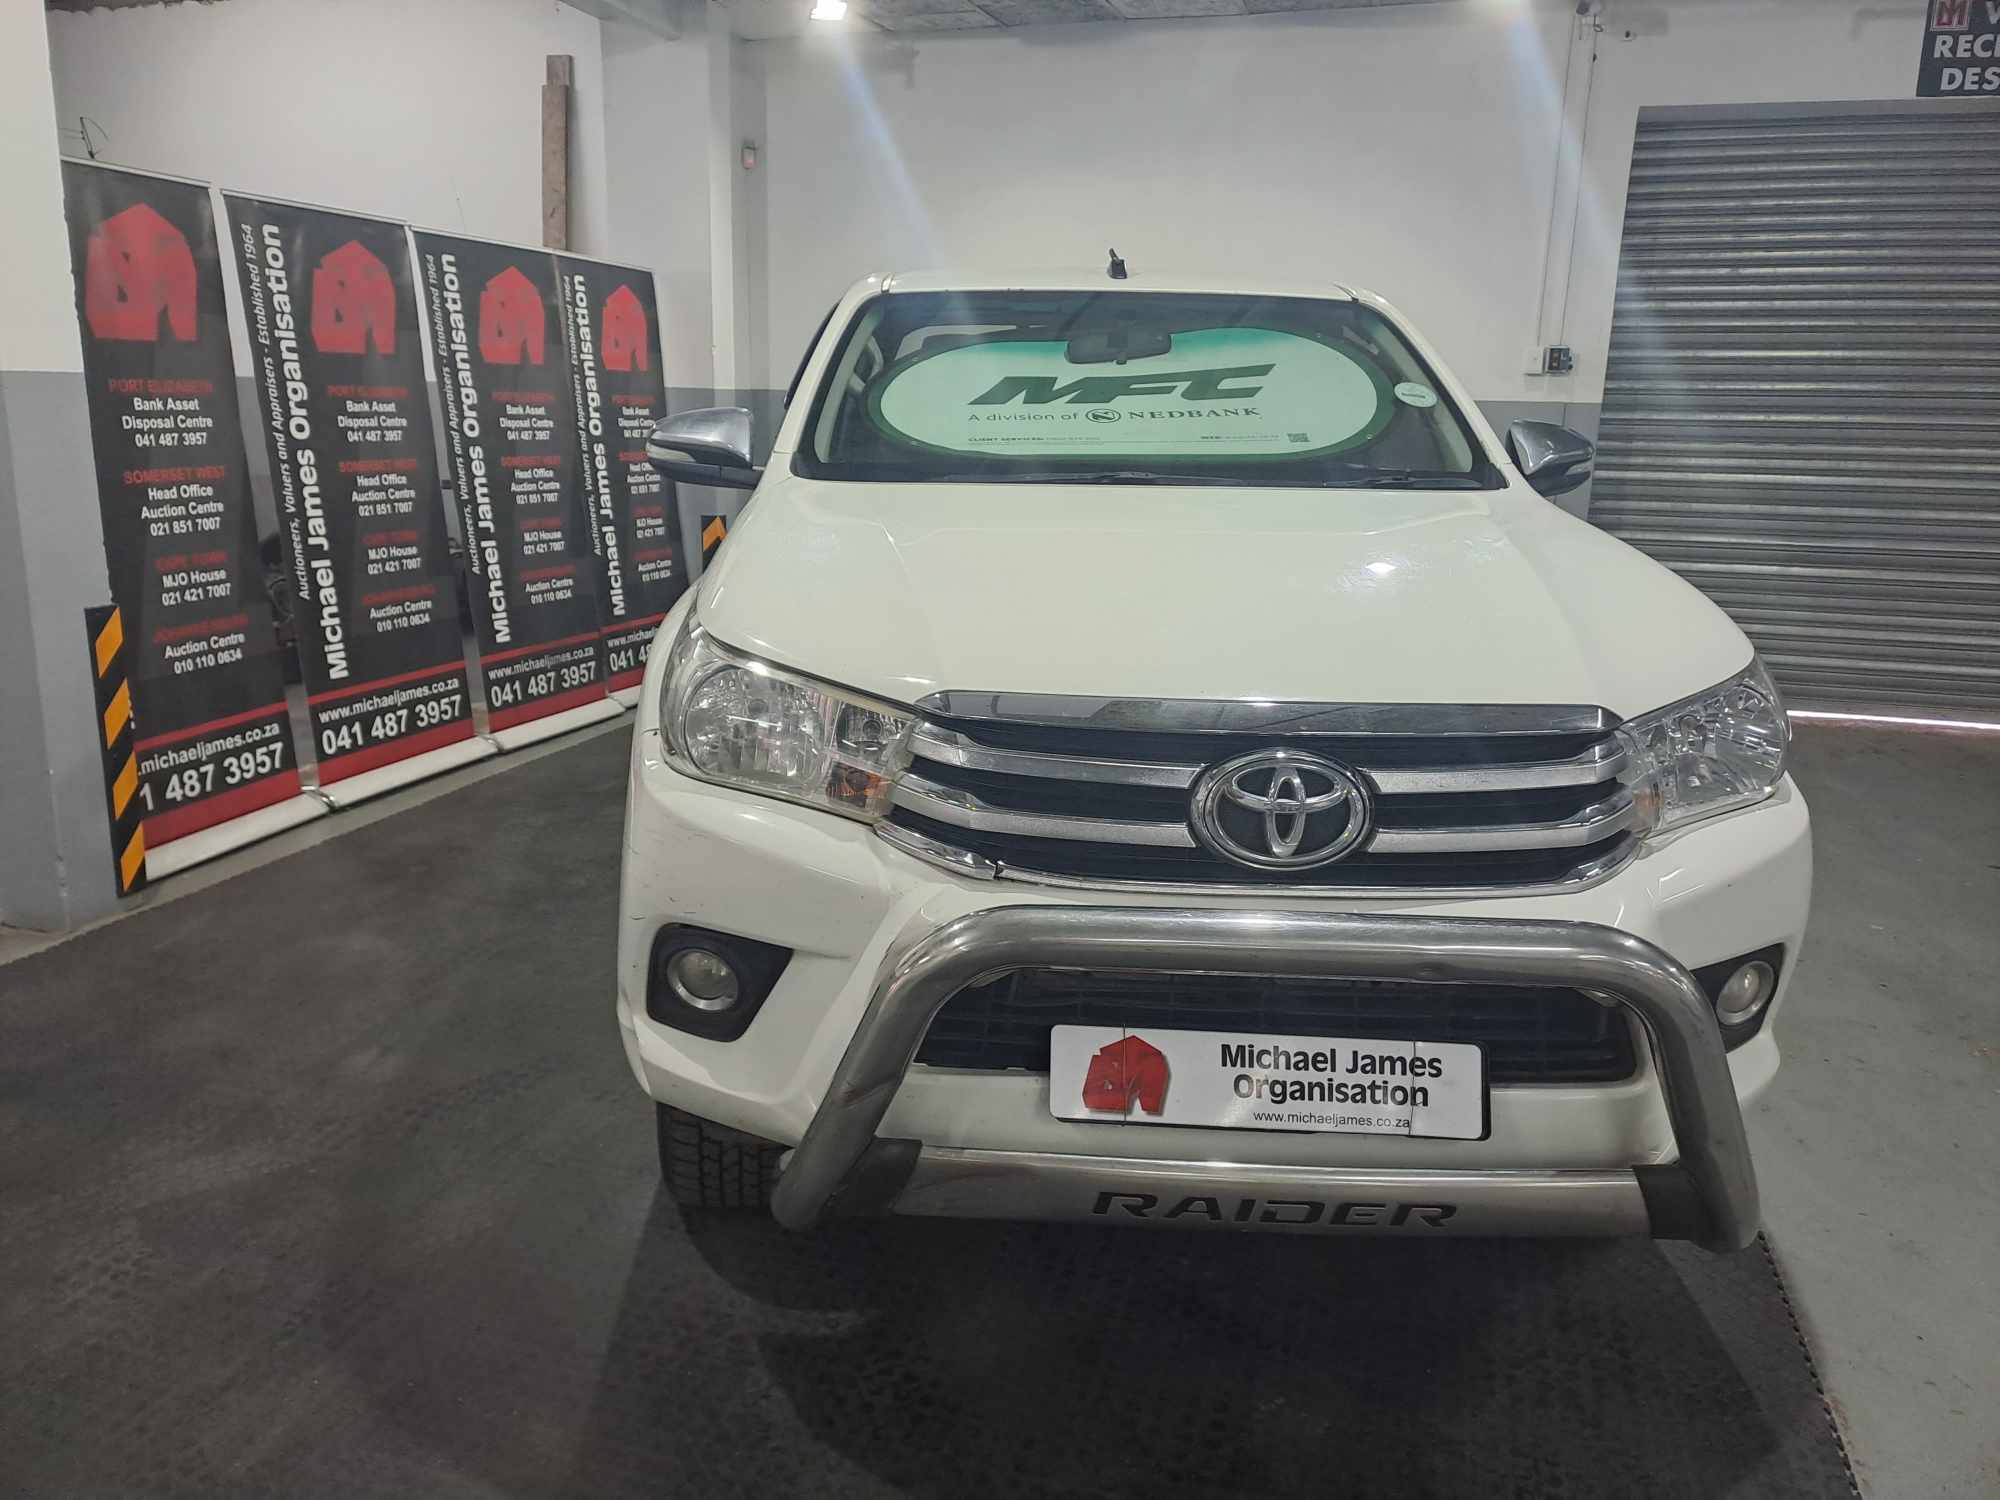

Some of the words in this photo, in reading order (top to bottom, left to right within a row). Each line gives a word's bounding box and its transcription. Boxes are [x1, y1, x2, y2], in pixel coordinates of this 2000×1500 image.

[249, 262, 270, 345] Established
[262, 224, 311, 440] Organisation
[441, 253, 480, 438] Organisation
[574, 274, 601, 436] Organisation
[263, 356, 287, 430] Appraisers
[967, 363, 1276, 405] MFC
[134, 397, 164, 410] Bank
[167, 398, 199, 410] Asset
[346, 400, 370, 412] Bank
[372, 401, 396, 412] Asset
[968, 413, 980, 422] A
[986, 411, 1054, 422] division
[1061, 411, 1079, 422] of
[1128, 407, 1261, 420] NEDBANK
[122, 415, 175, 430] Disposal
[177, 415, 213, 428] Centre
[337, 416, 378, 428] Disposal
[380, 416, 407, 427] Centre
[135, 434, 155, 447] 041
[159, 433, 178, 446] 487
[183, 432, 207, 445] 3957
[276, 431, 288, 460] and
[347, 431, 363, 442] 041
[452, 430, 463, 450] and
[282, 461, 297, 514] Valuers
[356, 475, 379, 487] Head
[381, 473, 407, 485] Office
[455, 452, 469, 500] Valuers
[469, 445, 495, 533] James
[593, 442, 613, 520] James
[148, 486, 177, 500] Head
[180, 484, 213, 498] Office
[297, 449, 329, 551] James
[352, 490, 386, 502] Auction
[388, 488, 416, 499] Centre
[141, 504, 186, 519] Auction
[188, 501, 224, 515] Centre
[359, 505, 374, 517] 021
[150, 522, 169, 536] 021
[173, 520, 193, 534] 851
[196, 517, 221, 531] 7007
[288, 518, 311, 600] Auctioneers,
[368, 548, 388, 560] MJO
[389, 545, 418, 557] House
[162, 572, 188, 588] MJO
[191, 569, 227, 583] House
[368, 563, 383, 575] 021
[385, 561, 400, 572] 421
[602, 525, 625, 616] Michael
[162, 592, 181, 606] 021
[184, 588, 204, 603] 421
[207, 583, 231, 598] 7007
[480, 540, 512, 643] Michael
[310, 559, 349, 680] Michael
[370, 604, 403, 619] Auction
[404, 600, 432, 612] Centre
[377, 621, 392, 632] 010
[164, 640, 208, 659] Auction
[210, 633, 245, 648] Centre
[610, 648, 634, 671] 041
[174, 659, 194, 674] 010
[197, 655, 215, 669] 110
[218, 649, 242, 664] 0634
[490, 680, 522, 707] 041
[527, 671, 556, 697] 487
[560, 661, 596, 688] 3957
[319, 678, 459, 724] www.michaeljames.co.za
[322, 721, 364, 755] 041
[370, 709, 409, 739] 487
[415, 694, 461, 728] 3957
[138, 722, 280, 775] .michaeljames.co.za
[165, 764, 215, 801] 487
[224, 741, 283, 784] 3957
[1220, 1043, 1337, 1073] Michael
[1346, 1049, 1443, 1079] James
[1233, 1073, 1430, 1108] Organisation
[1253, 1110, 1411, 1129] www.michaeljames.co.za
[1092, 1190, 1457, 1229] RAIDER
